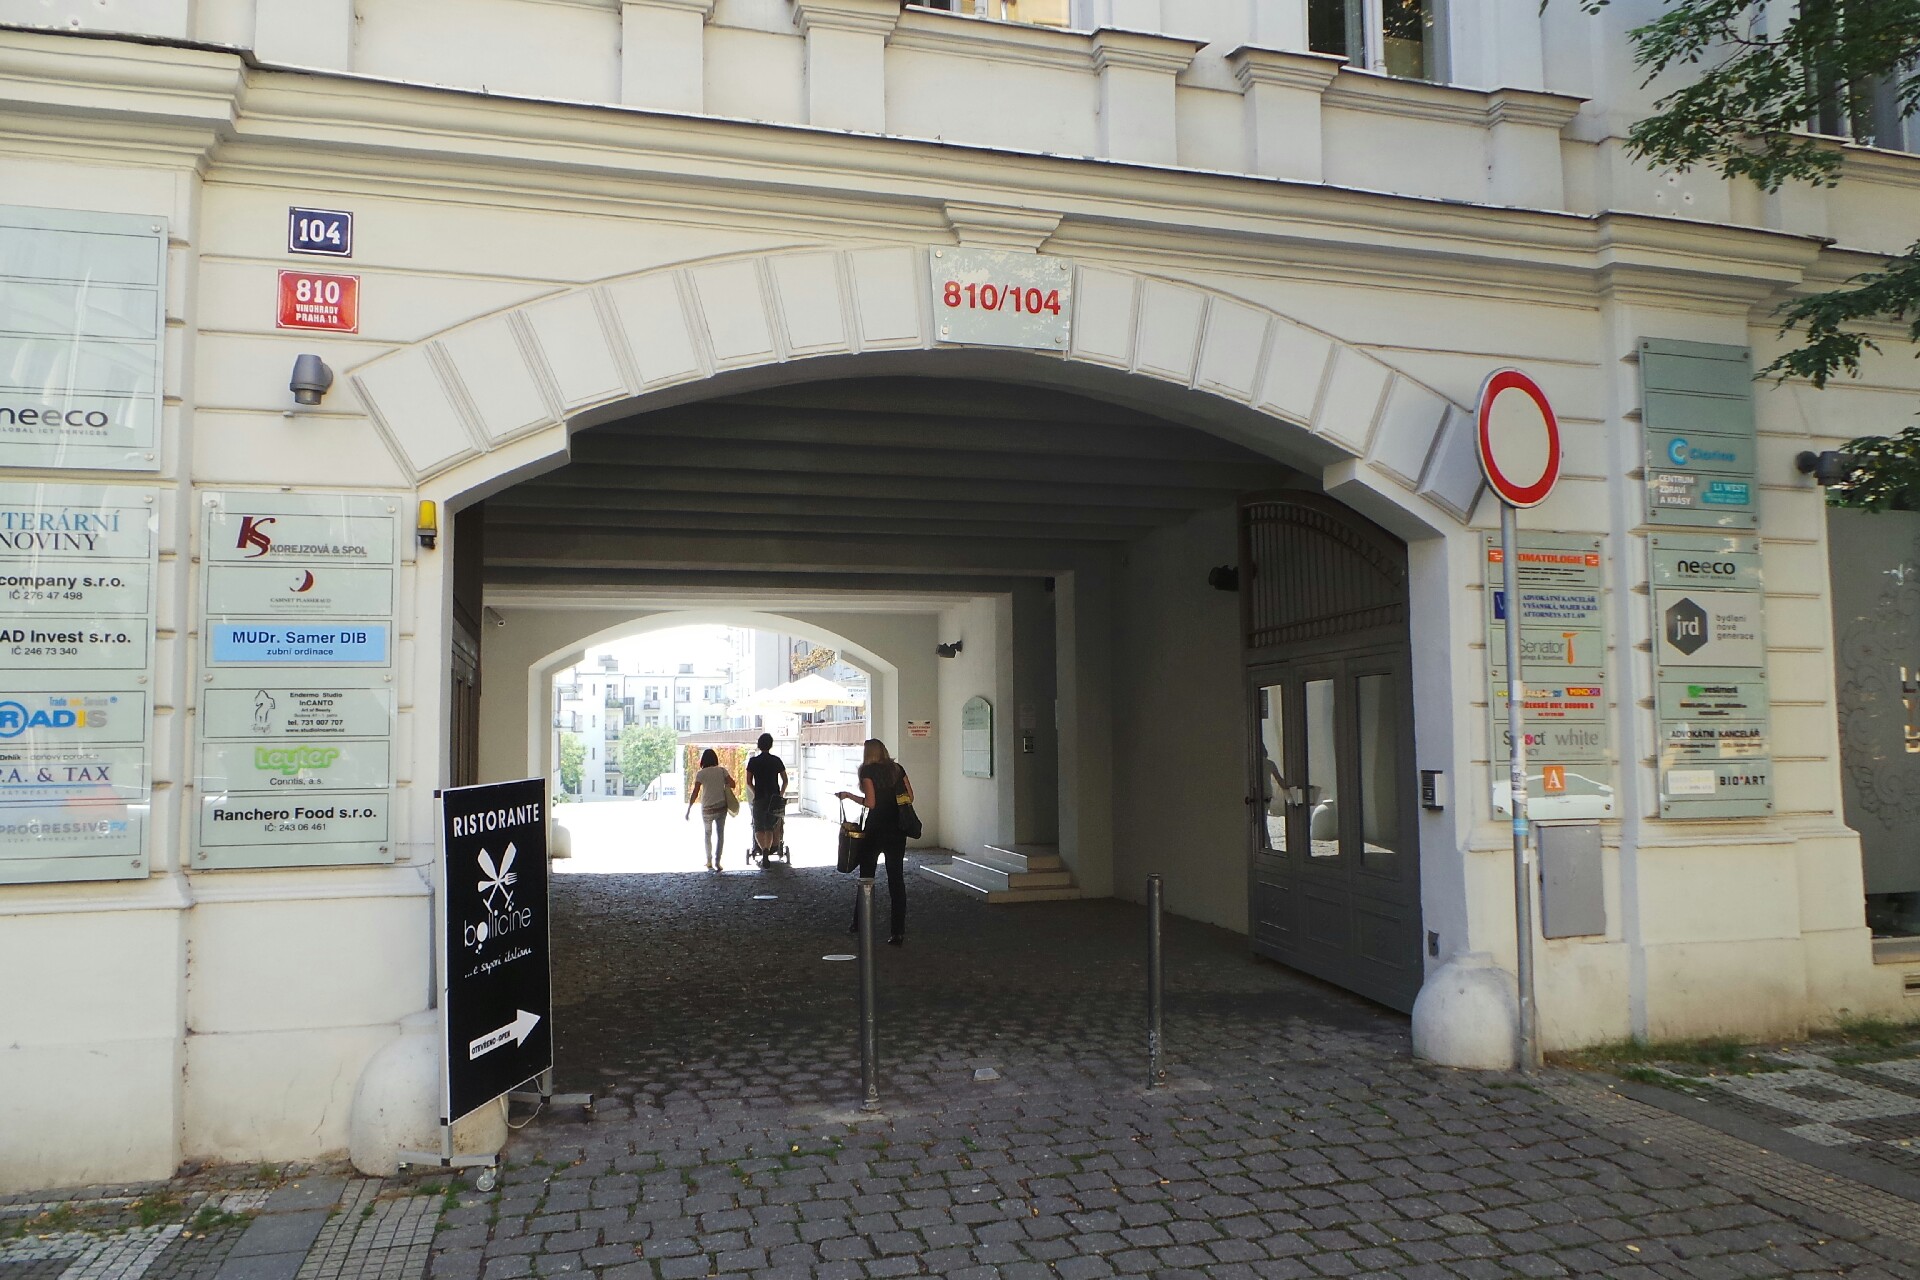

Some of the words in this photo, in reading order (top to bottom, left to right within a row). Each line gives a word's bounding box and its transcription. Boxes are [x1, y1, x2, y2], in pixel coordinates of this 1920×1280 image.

[300, 219, 340, 244] 104
[296, 279, 340, 304] 810
[944, 281, 1060, 315] 810/104
[296, 304, 338, 314] VINOHRADY
[296, 313, 326, 322] PRAHA
[328, 315, 338, 324] 10
[1659, 474, 1694, 484] CENTRUM
[1660, 485, 1686, 494] ZDRAVÍ
[1668, 495, 1691, 504] KRÁSY
[0, 532, 98, 550] NOVINY
[270, 544, 330, 554] KOREJZOVÁ
[332, 546, 340, 554] &
[1678, 560, 1736, 574] neeco
[83, 577, 126, 587] s.r.o.
[9, 590, 20, 600] IČ
[1676, 614, 1700, 640] jrd
[30, 630, 84, 642] Invest
[90, 633, 131, 643] s.r.o.
[232, 631, 280, 644] MUDr.
[286, 632, 336, 644] Samer
[340, 632, 367, 644] DIB
[11, 645, 21, 655] IČ
[1554, 728, 1600, 746] white
[1718, 728, 1760, 738] KANCELÁŘ
[37, 767, 54, 782] &
[63, 766, 110, 781] TAX
[214, 808, 289, 821] Ranchero
[294, 807, 334, 819] Food
[339, 808, 377, 818] s.r.o.
[454, 803, 540, 837] RISTORANTE
[264, 823, 276, 832] IČ:
[464, 905, 532, 948] bollicine
[499, 1030, 511, 1042] OPEN
